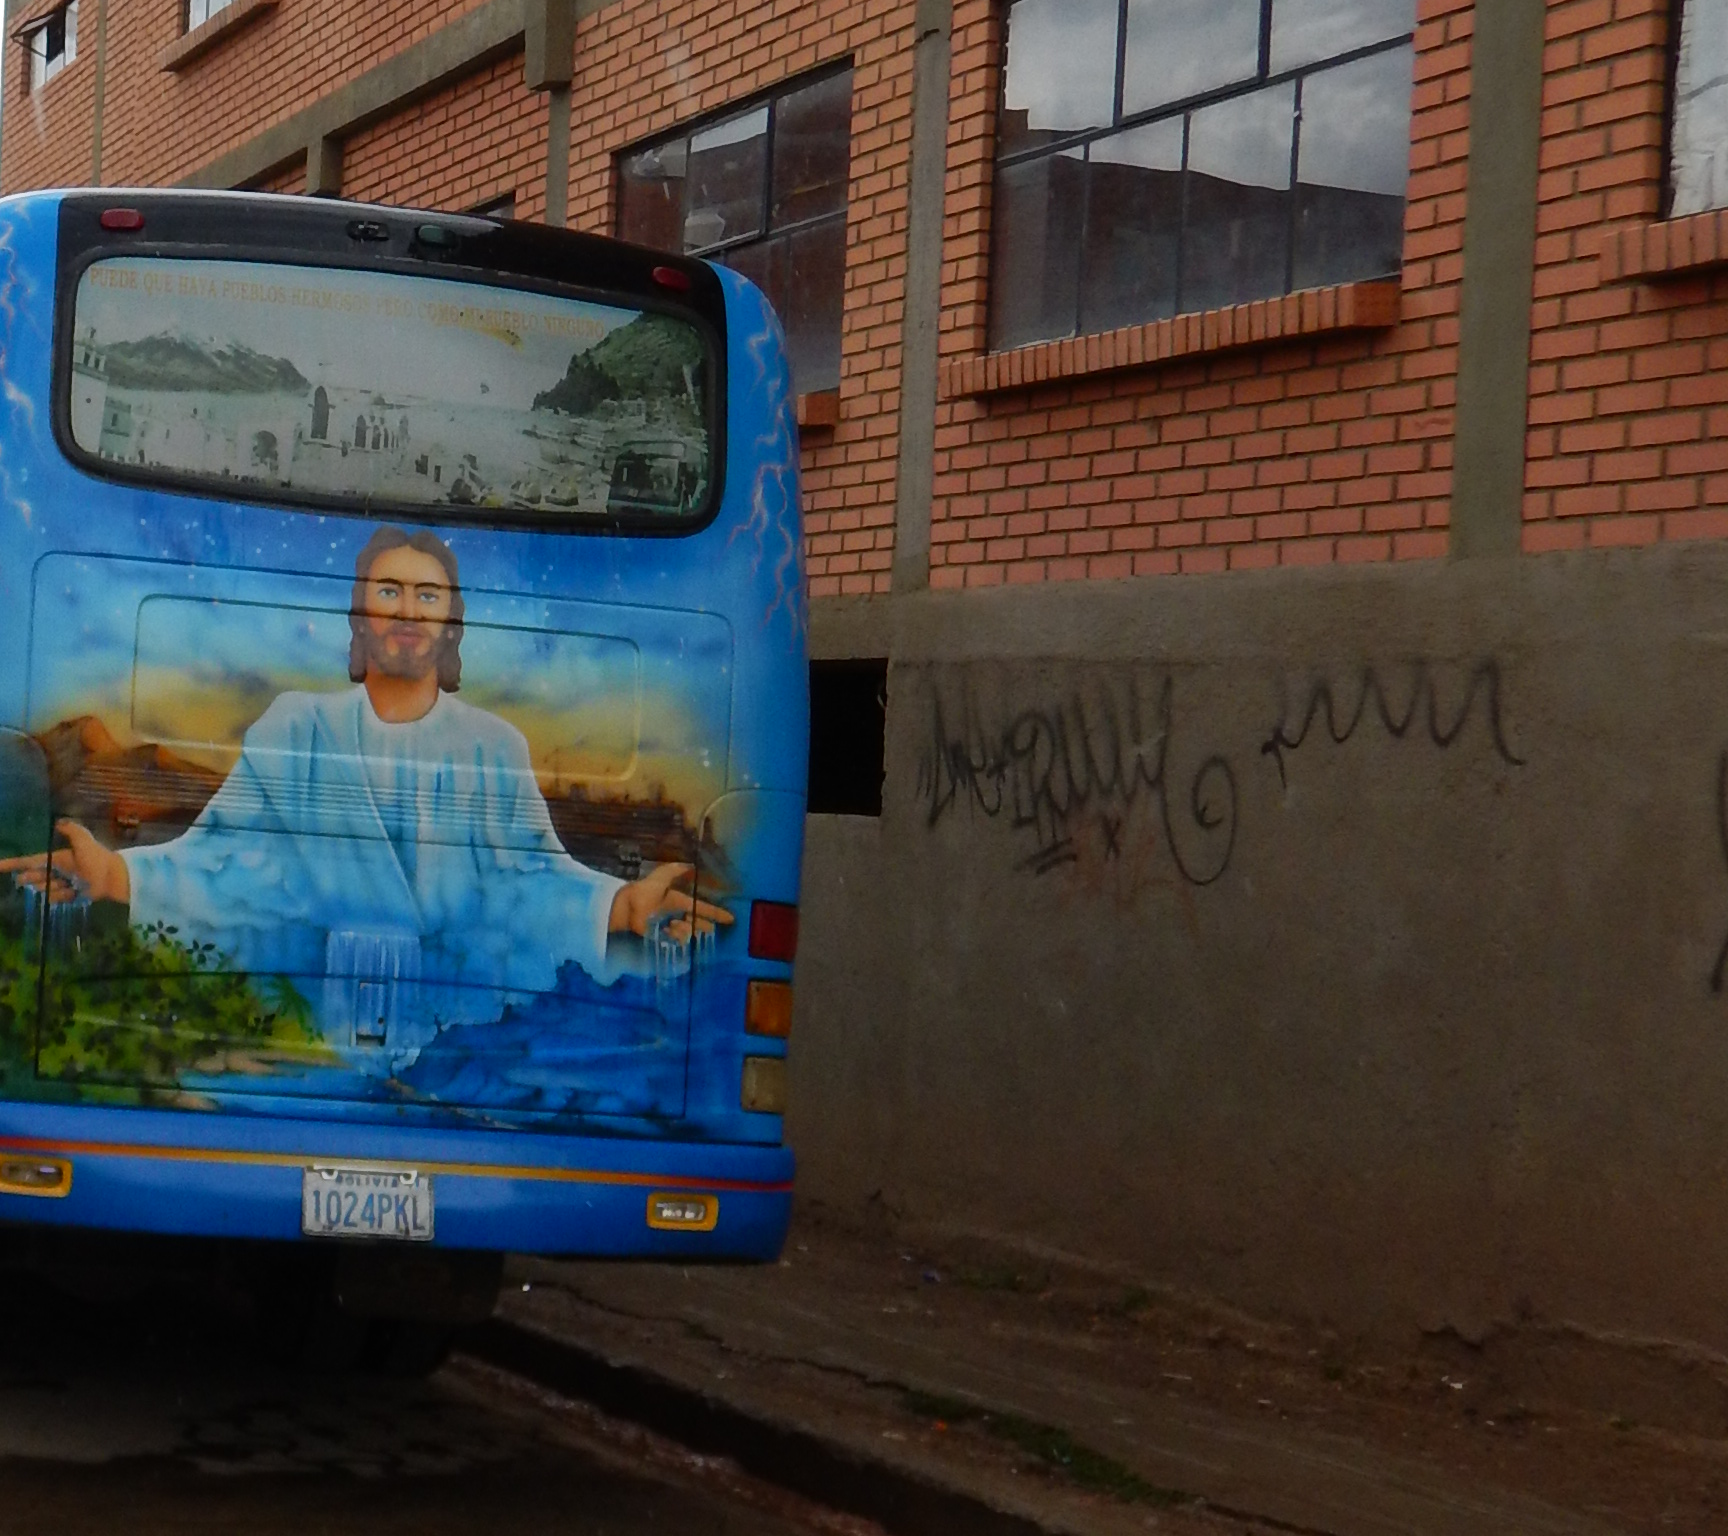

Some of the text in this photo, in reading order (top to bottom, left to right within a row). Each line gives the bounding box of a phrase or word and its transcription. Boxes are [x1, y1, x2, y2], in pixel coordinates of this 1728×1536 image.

[89, 267, 137, 289] PUEDE
[143, 272, 173, 297] QUE
[178, 276, 217, 298] HAYA
[222, 280, 288, 306] PUEBLOS
[543, 314, 605, 340] NINGUNO
[313, 1189, 426, 1232] 1024PKL
